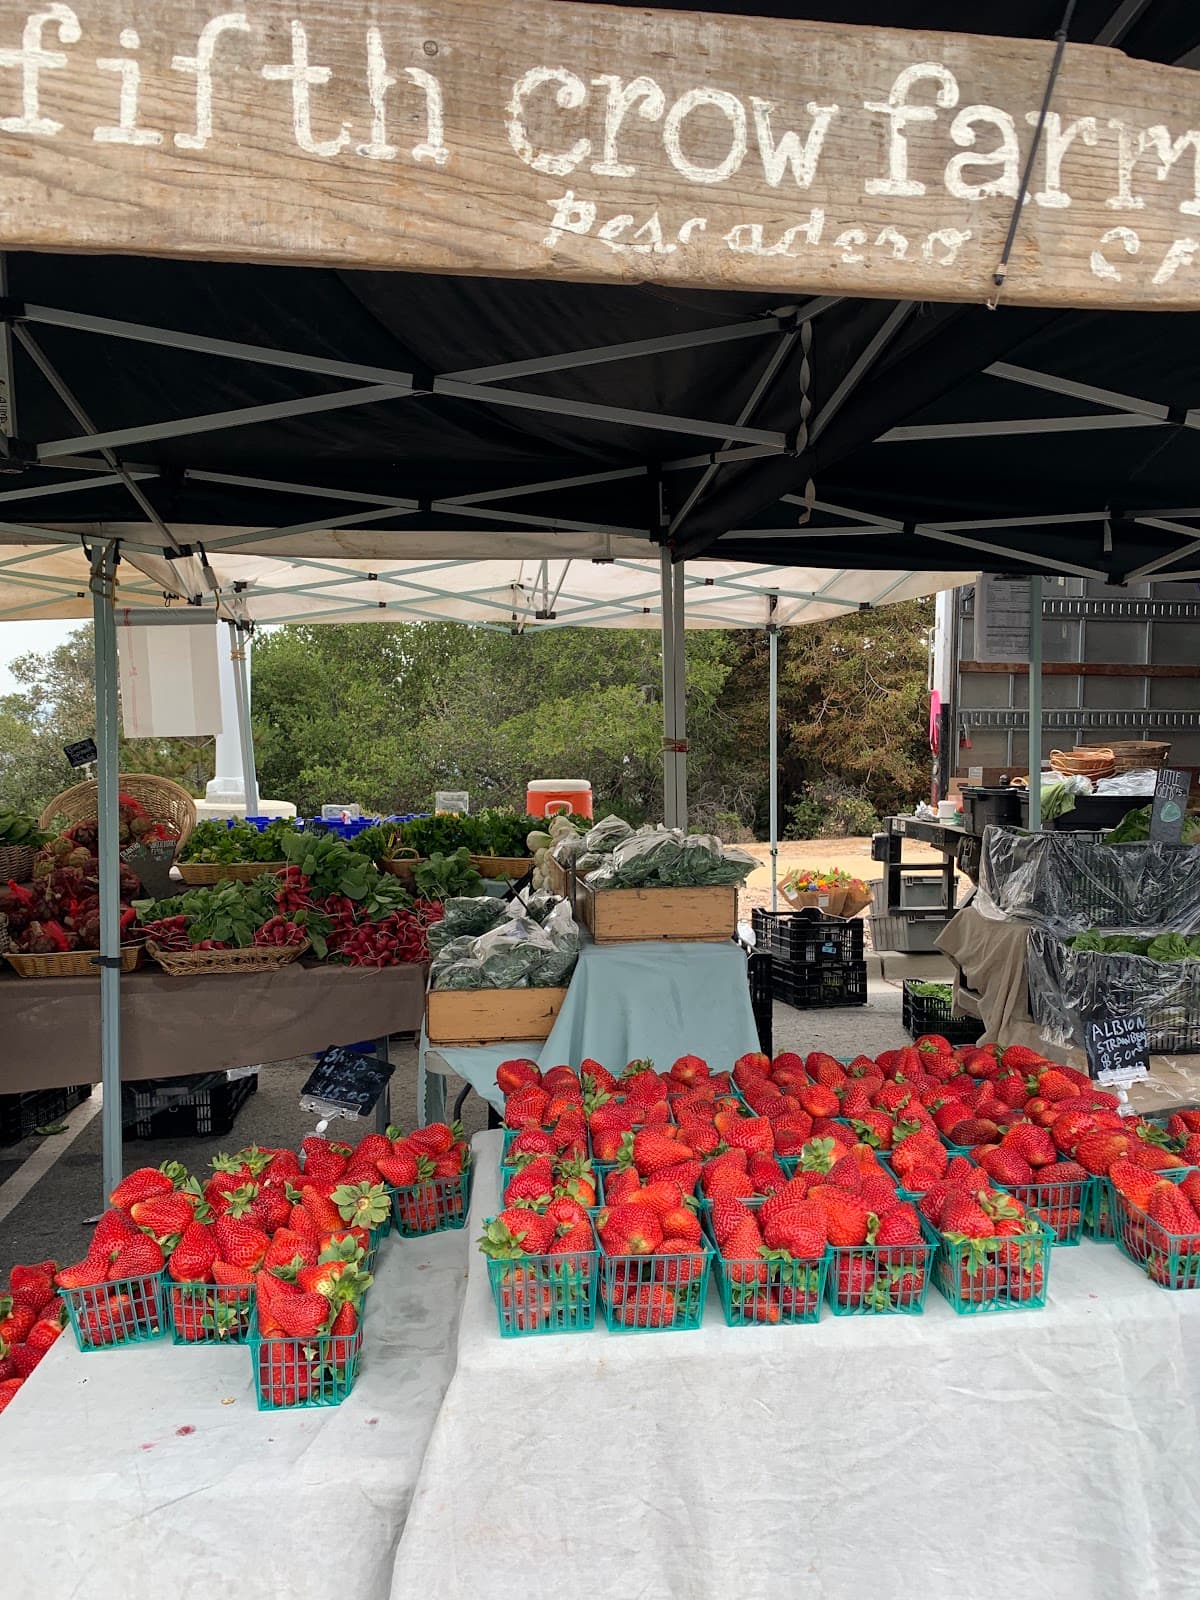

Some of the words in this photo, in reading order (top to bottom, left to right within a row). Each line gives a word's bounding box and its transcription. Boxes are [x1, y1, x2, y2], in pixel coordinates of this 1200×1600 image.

[0, 3, 450, 164] fifth
[505, 65, 839, 188] crow
[863, 61, 1200, 218] farm
[1091, 1016, 1146, 1042] ALBION
